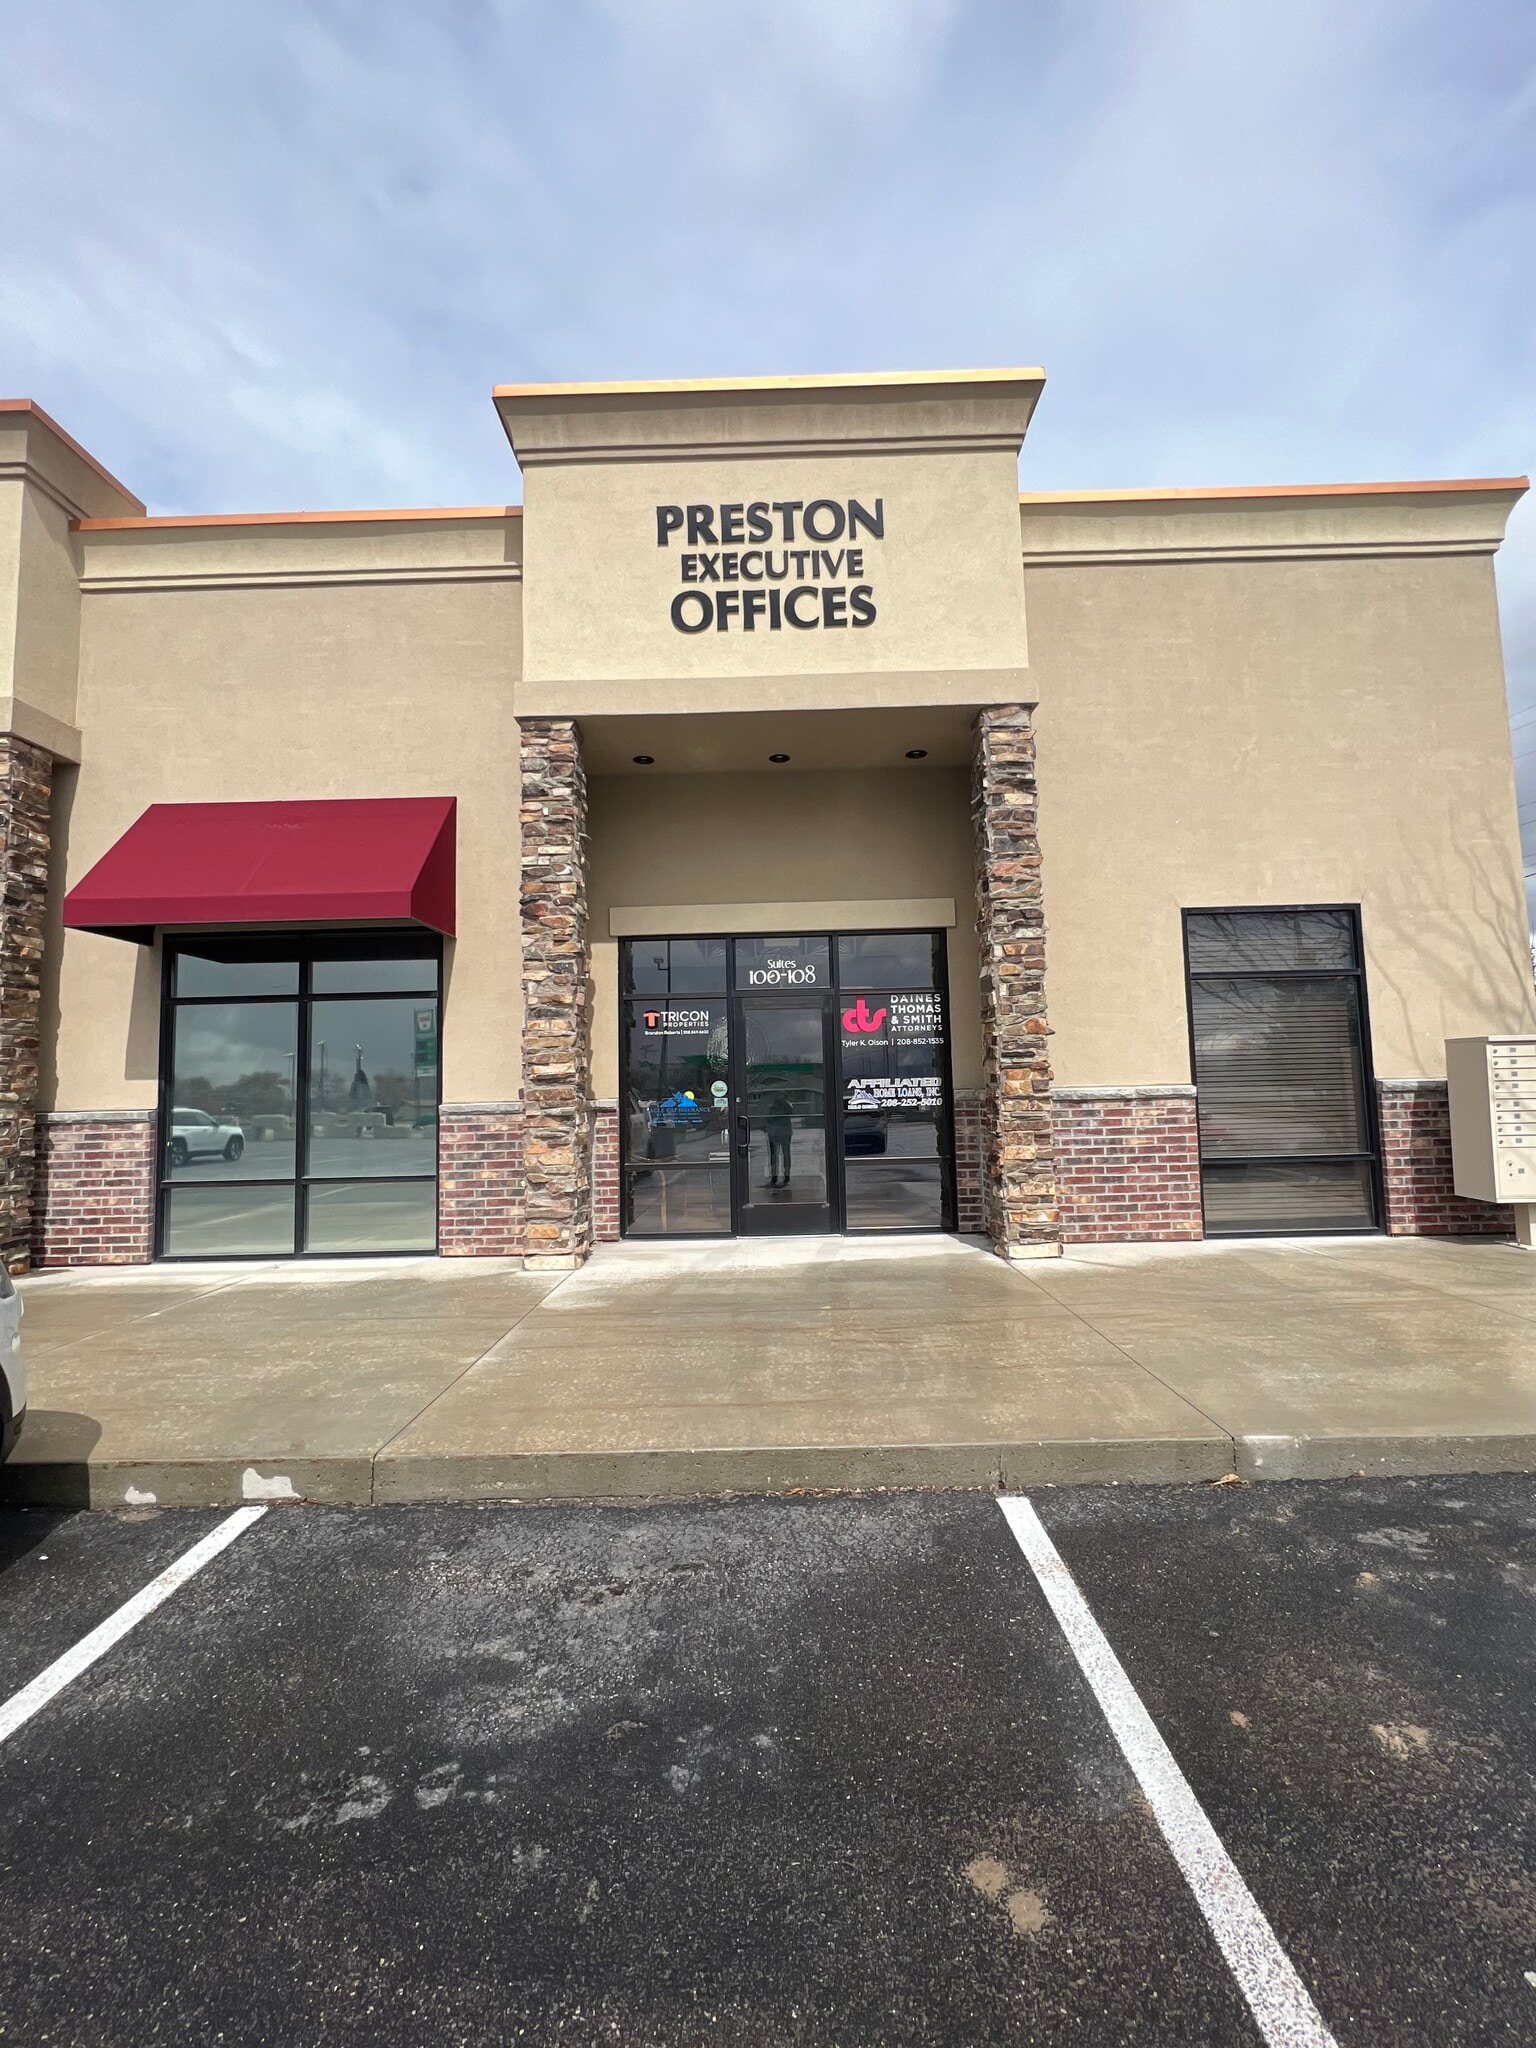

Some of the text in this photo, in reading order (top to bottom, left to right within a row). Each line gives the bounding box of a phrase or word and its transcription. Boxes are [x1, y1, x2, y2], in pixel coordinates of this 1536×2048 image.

[657, 498, 884, 547] PRESTON
[681, 548, 864, 582] EXECUTIVE
[671, 585, 877, 634] OFFICES
[767, 959, 797, 968] Suites
[749, 965, 816, 984] 100-108
[890, 994, 941, 1003] DAINES
[890, 1004, 942, 1014] THOMAS
[660, 1010, 709, 1021] TRICON
[891, 1014, 942, 1024] & SMITH
[847, 1077, 942, 1088] AFFILIATED
[873, 1088, 896, 1097] HOME
[881, 1098, 942, 1107] 208-252-5010
